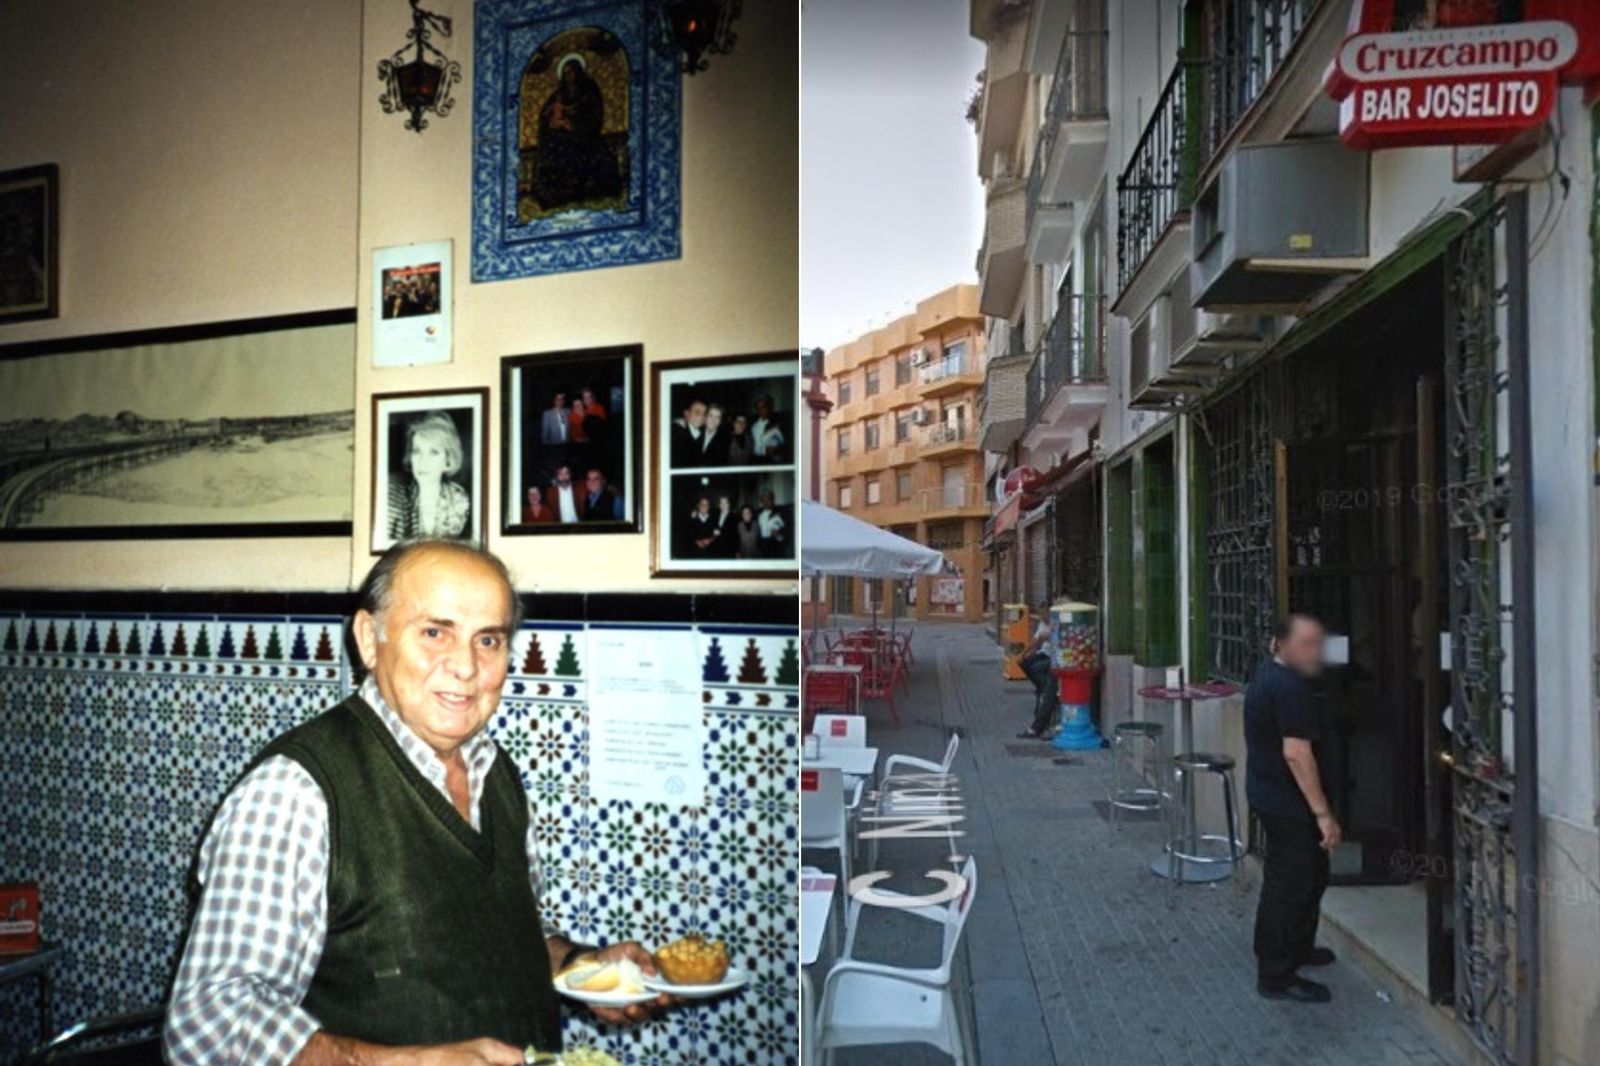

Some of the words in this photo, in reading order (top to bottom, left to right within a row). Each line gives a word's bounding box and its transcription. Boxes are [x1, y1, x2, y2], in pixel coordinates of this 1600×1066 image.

[1356, 37, 1558, 73] Cruzcampo
[1361, 87, 1411, 122] BAR
[1417, 81, 1539, 119] JOSELITO
